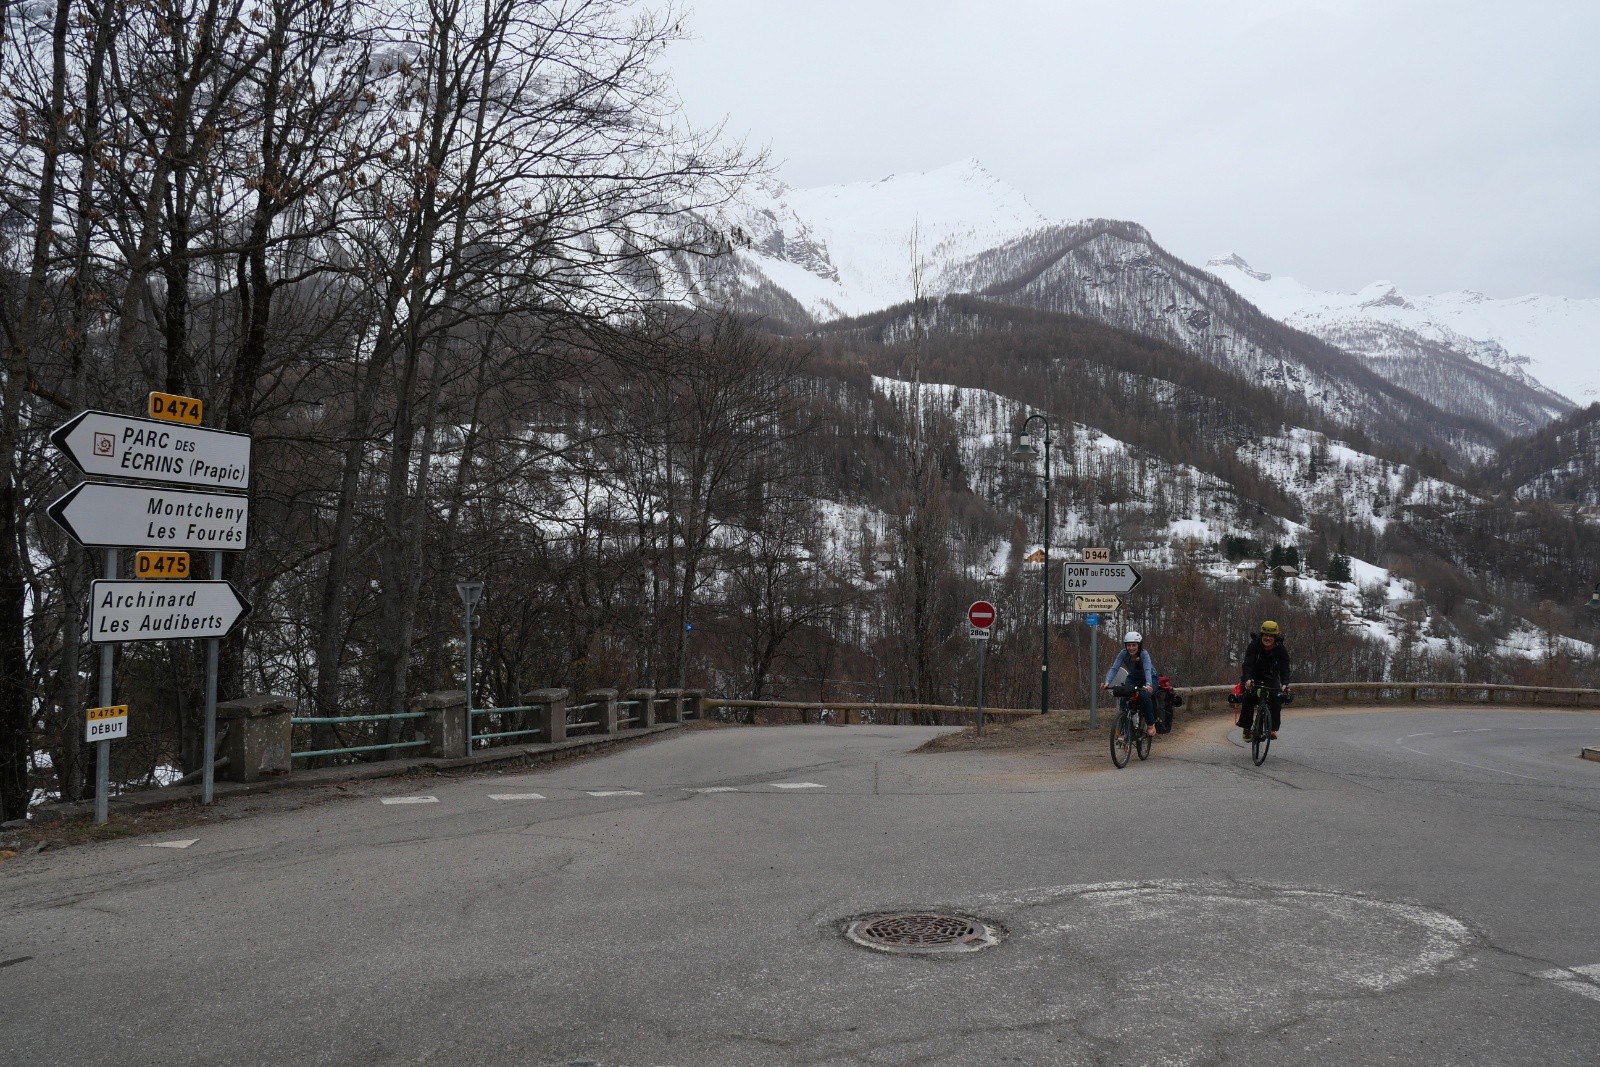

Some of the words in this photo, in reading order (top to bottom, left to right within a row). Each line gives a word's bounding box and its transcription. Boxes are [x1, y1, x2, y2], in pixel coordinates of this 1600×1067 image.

[122, 427, 170, 449] PARC
[175, 439, 196, 452] DES
[121, 446, 184, 474] ÉCRINS
[189, 458, 246, 482] (Prapic)
[147, 497, 244, 524] Montcheny
[147, 522, 176, 539] Les
[186, 523, 243, 542] Fourés
[1068, 567, 1090, 577] PONT
[1100, 568, 1126, 577] FOSSE
[1068, 579, 1087, 588] GAP
[101, 590, 197, 608] Archinard
[99, 615, 130, 633] Les
[139, 614, 223, 631] Audiberts
[91, 722, 123, 736] DÉBUT
